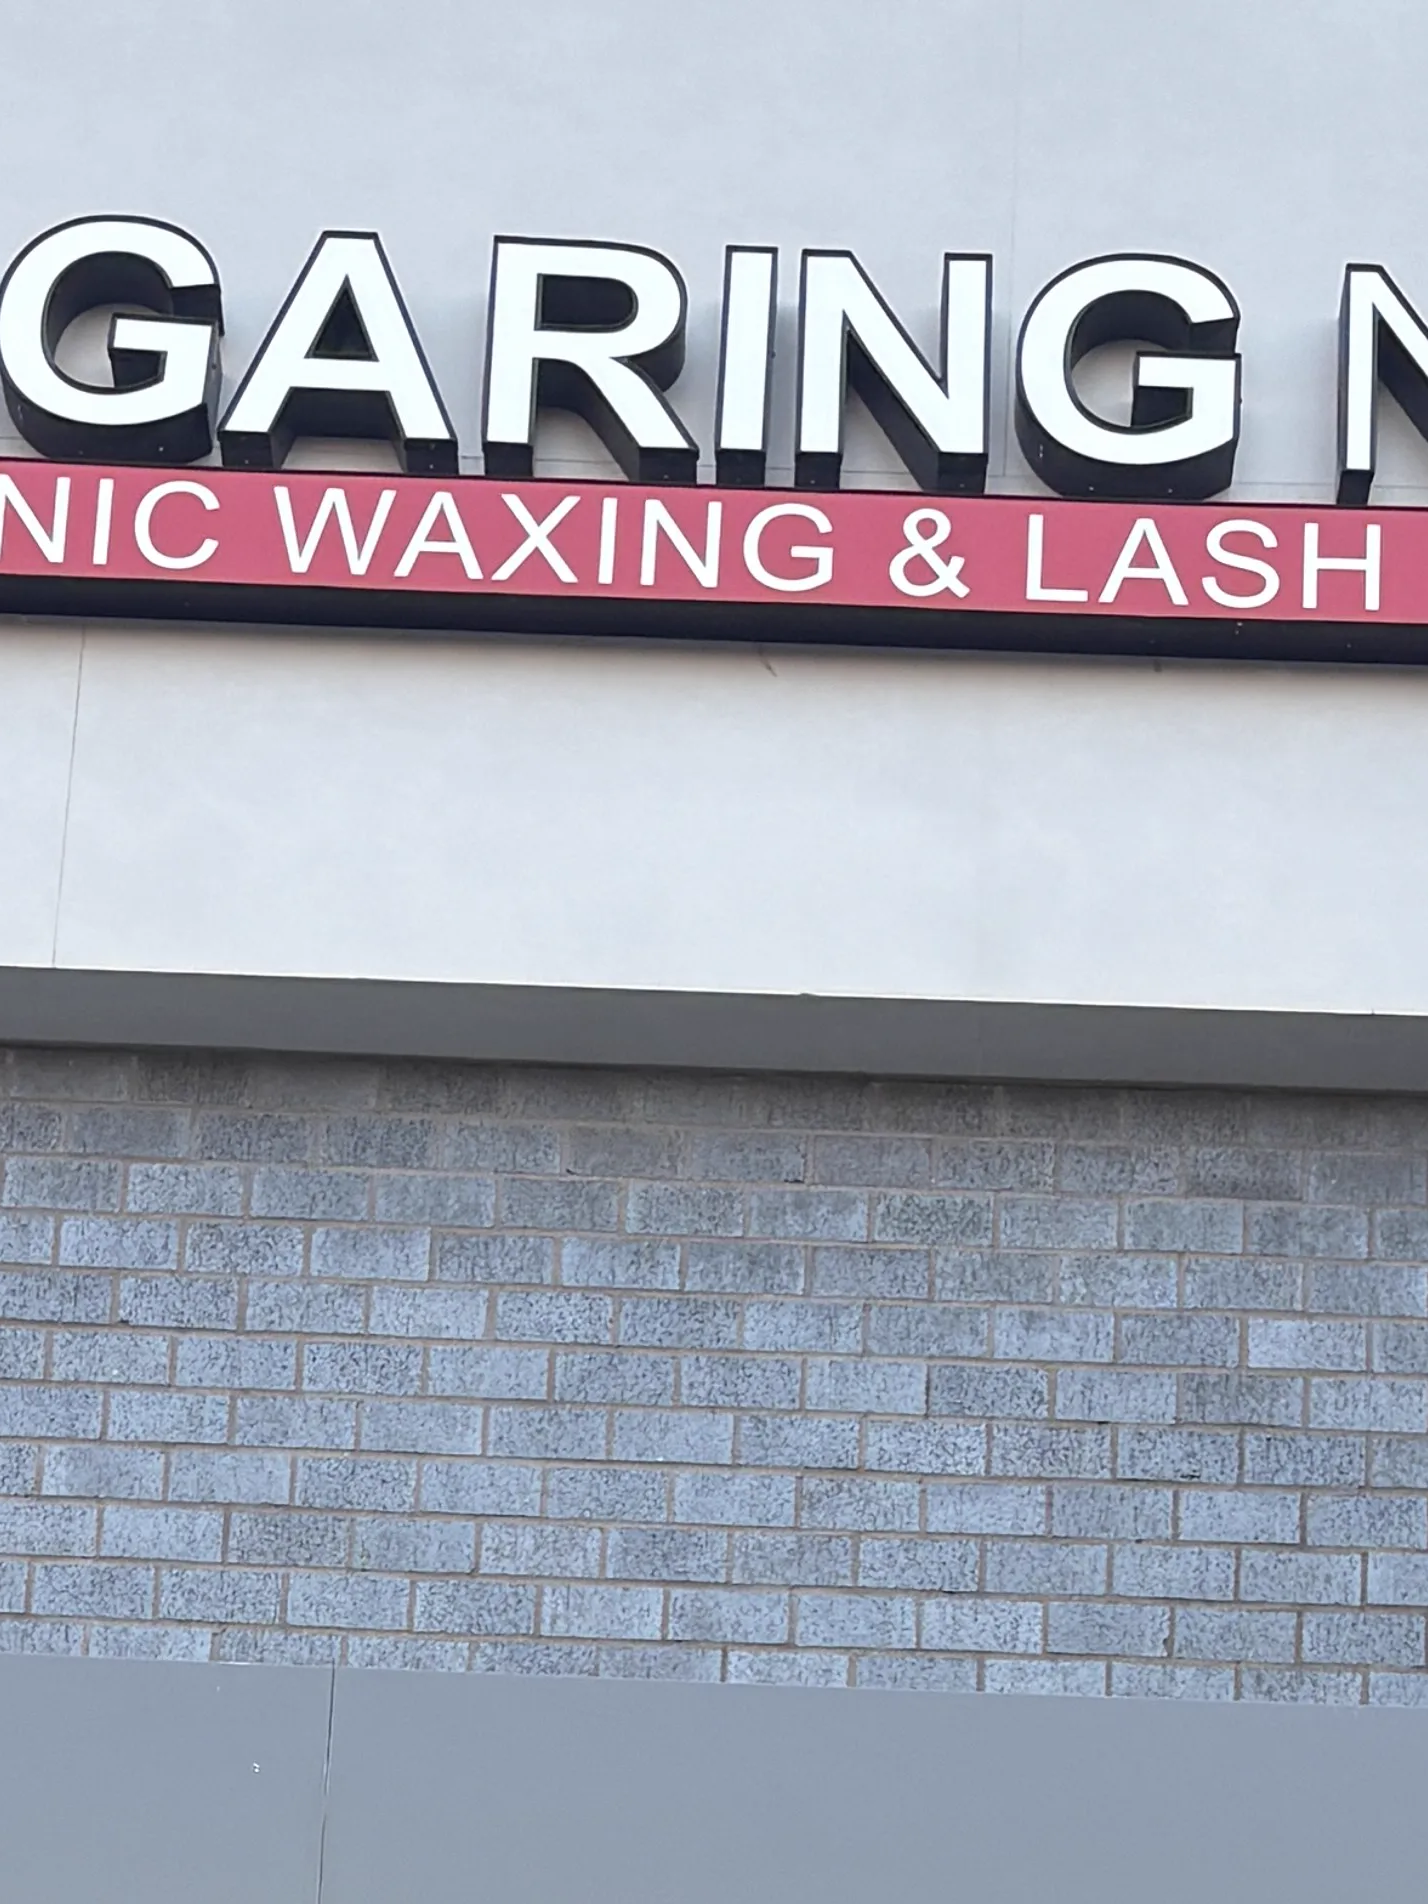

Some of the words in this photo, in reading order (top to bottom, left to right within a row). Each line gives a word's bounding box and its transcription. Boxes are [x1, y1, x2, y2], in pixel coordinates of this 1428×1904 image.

[274, 482, 838, 596] WAXING
[887, 506, 971, 598] &
[1023, 512, 1382, 611] LASH
